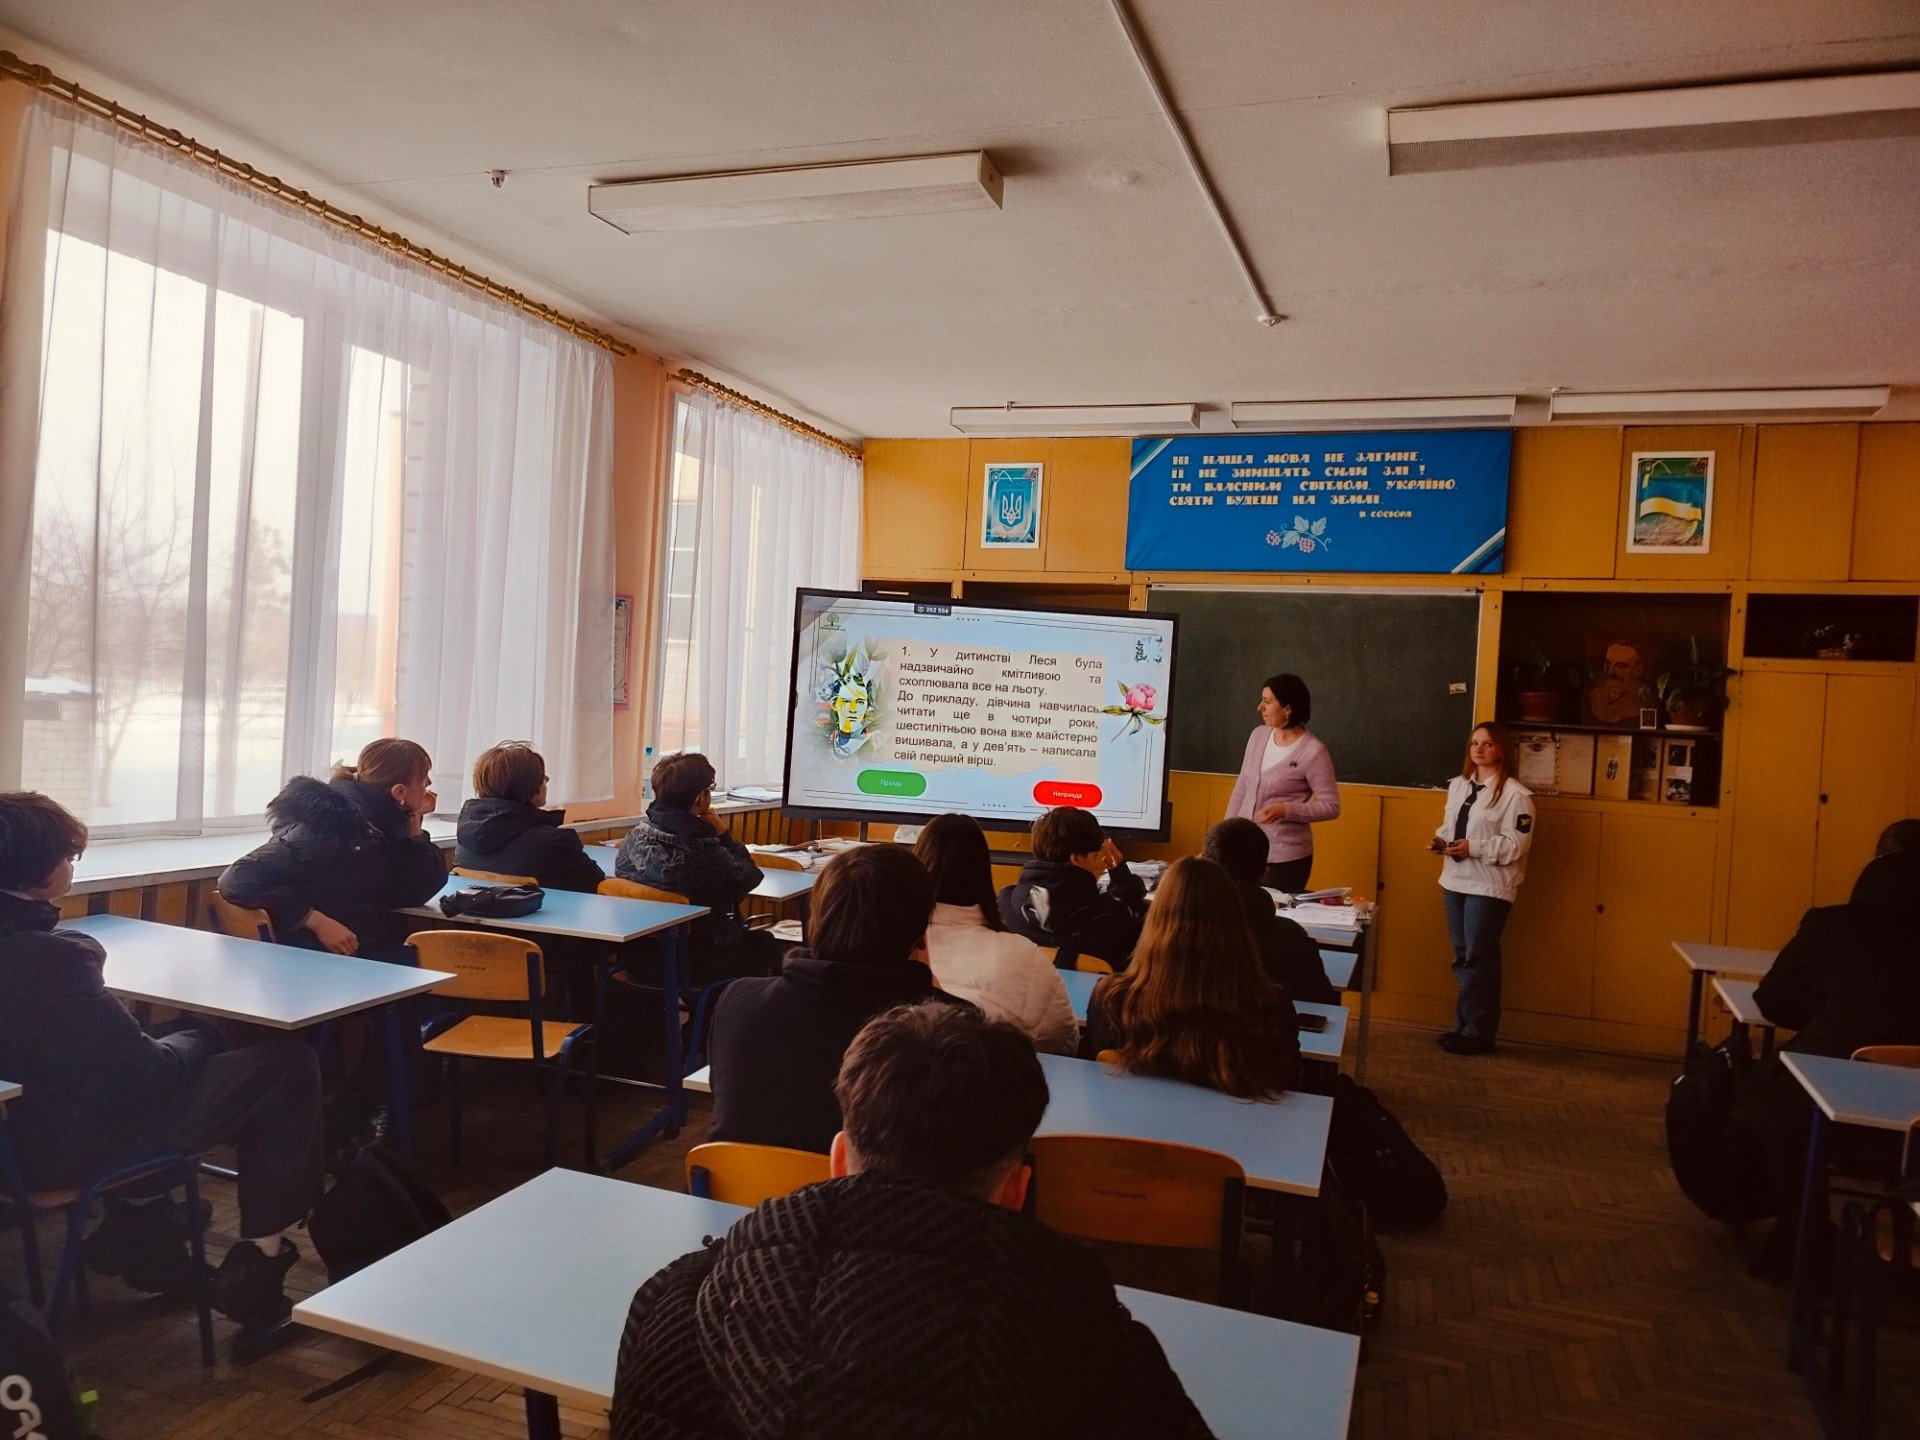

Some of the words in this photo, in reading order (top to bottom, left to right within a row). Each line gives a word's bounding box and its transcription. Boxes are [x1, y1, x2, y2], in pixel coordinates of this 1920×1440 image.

[1202, 454, 1254, 465] НАША
[1264, 453, 1310, 464] МОВА
[1324, 452, 1345, 463] НЕ
[1198, 468, 1218, 478] НЕ
[1324, 466, 1368, 476] СИЛИ
[1382, 465, 1410, 476] ЗЛІ
[1171, 482, 1192, 493] ТИ
[1204, 481, 1283, 492] ВЛАСНИМ
[1169, 495, 1214, 507] СІЯТИ
[1226, 494, 1279, 506] БУДЕШ
[1292, 494, 1316, 505] НА
[901, 646, 911, 657] 1.
[929, 647, 939, 658] У
[955, 650, 1011, 663] дитинстві
[1028, 654, 1057, 666] Леся
[1075, 657, 1103, 670] була
[900, 662, 974, 675] надзвичайно
[1001, 668, 1061, 681] кмітливою
[1088, 675, 1101, 684] та
[898, 677, 969, 690] схоплювала
[972, 682, 992, 691] все
[995, 684, 1009, 693] на
[1011, 685, 1047, 697] льоту.
[897, 691, 914, 702] До
[922, 693, 979, 708] прикладу,
[986, 697, 1031, 709] дівчина
[896, 707, 936, 718] читати
[953, 711, 971, 721] ще
[987, 713, 995, 721] в
[1011, 714, 1051, 726] чотири
[1068, 718, 1098, 730] роки,
[895, 722, 977, 735] шестилітньою
[980, 727, 1007, 737] вона
[1011, 729, 1033, 739] вже
[1036, 730, 1098, 744] майстерно
[894, 736, 956, 750] вишивала,
[961, 741, 969, 749] а
[972, 742, 980, 753] у
[1042, 746, 1097, 758] написала
[893, 751, 917, 761] свій
[919, 753, 964, 765] перший
[967, 754, 997, 767] вірш.
[1052, 790, 1083, 799] Неправда
